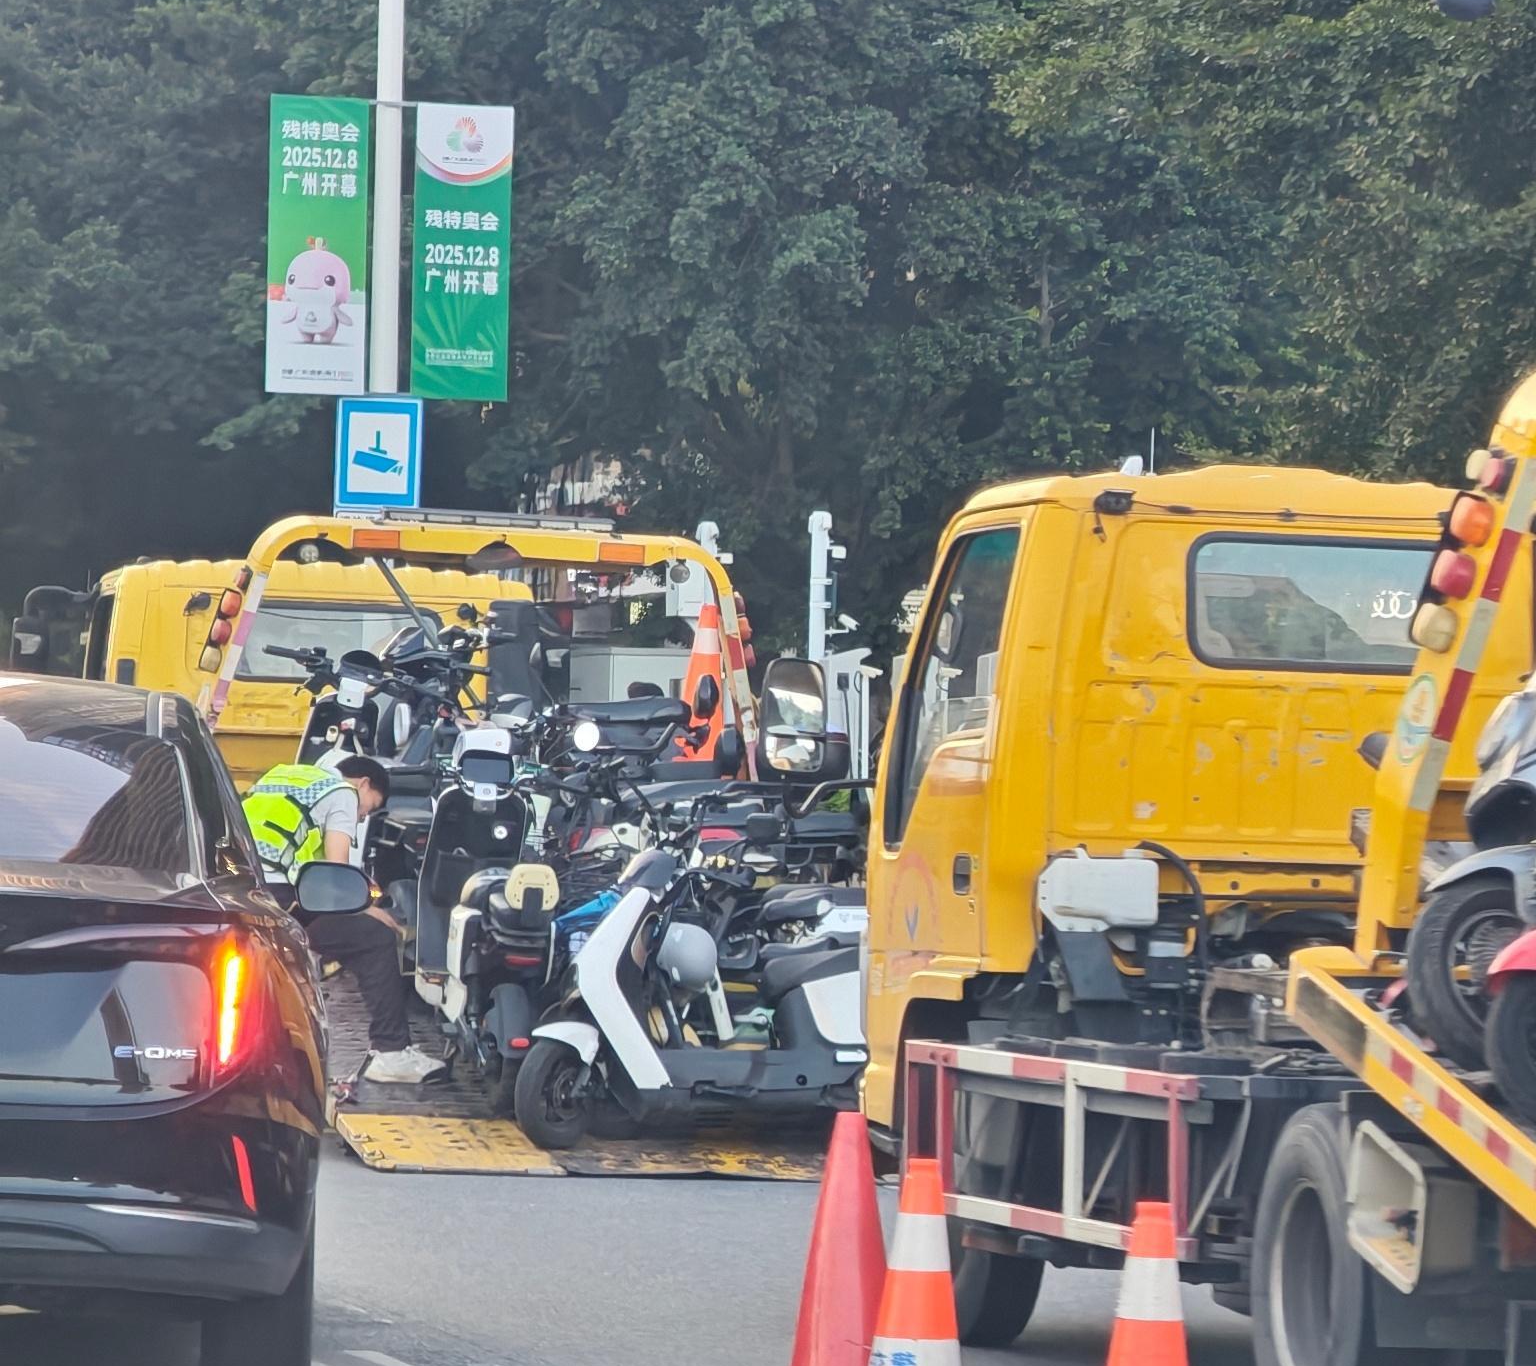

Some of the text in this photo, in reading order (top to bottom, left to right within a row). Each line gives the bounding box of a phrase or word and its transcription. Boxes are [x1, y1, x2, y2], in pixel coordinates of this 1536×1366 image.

[281, 120, 360, 142] 残特奥会
[281, 146, 358, 169] 2025.12.8
[282, 171, 357, 198] 广州开幕
[425, 209, 499, 231] 残特奥会
[425, 243, 499, 267] 2025.12.8
[425, 267, 498, 295] 广州开幕
